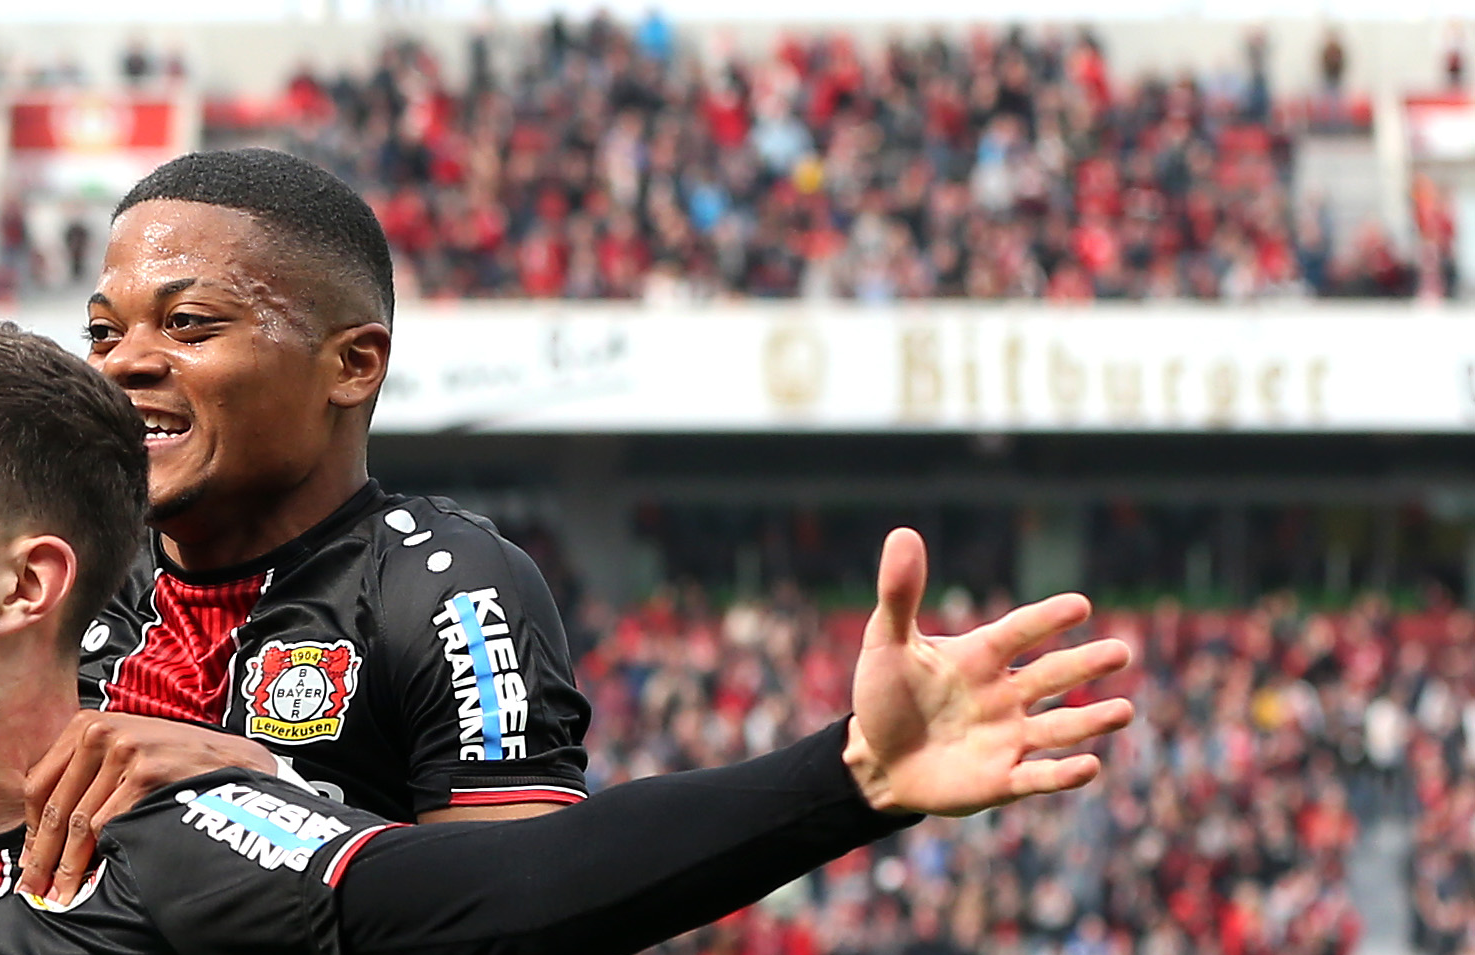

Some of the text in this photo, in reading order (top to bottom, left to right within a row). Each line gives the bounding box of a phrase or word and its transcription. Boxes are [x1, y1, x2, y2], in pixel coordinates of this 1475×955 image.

[293, 650, 319, 662] 1904
[276, 688, 322, 698] BAYER
[290, 668, 307, 718] BAYER
[432, 599, 485, 760] TRAINNG
[256, 719, 332, 737] Leverkusen
[181, 800, 315, 872] TRAINIG
